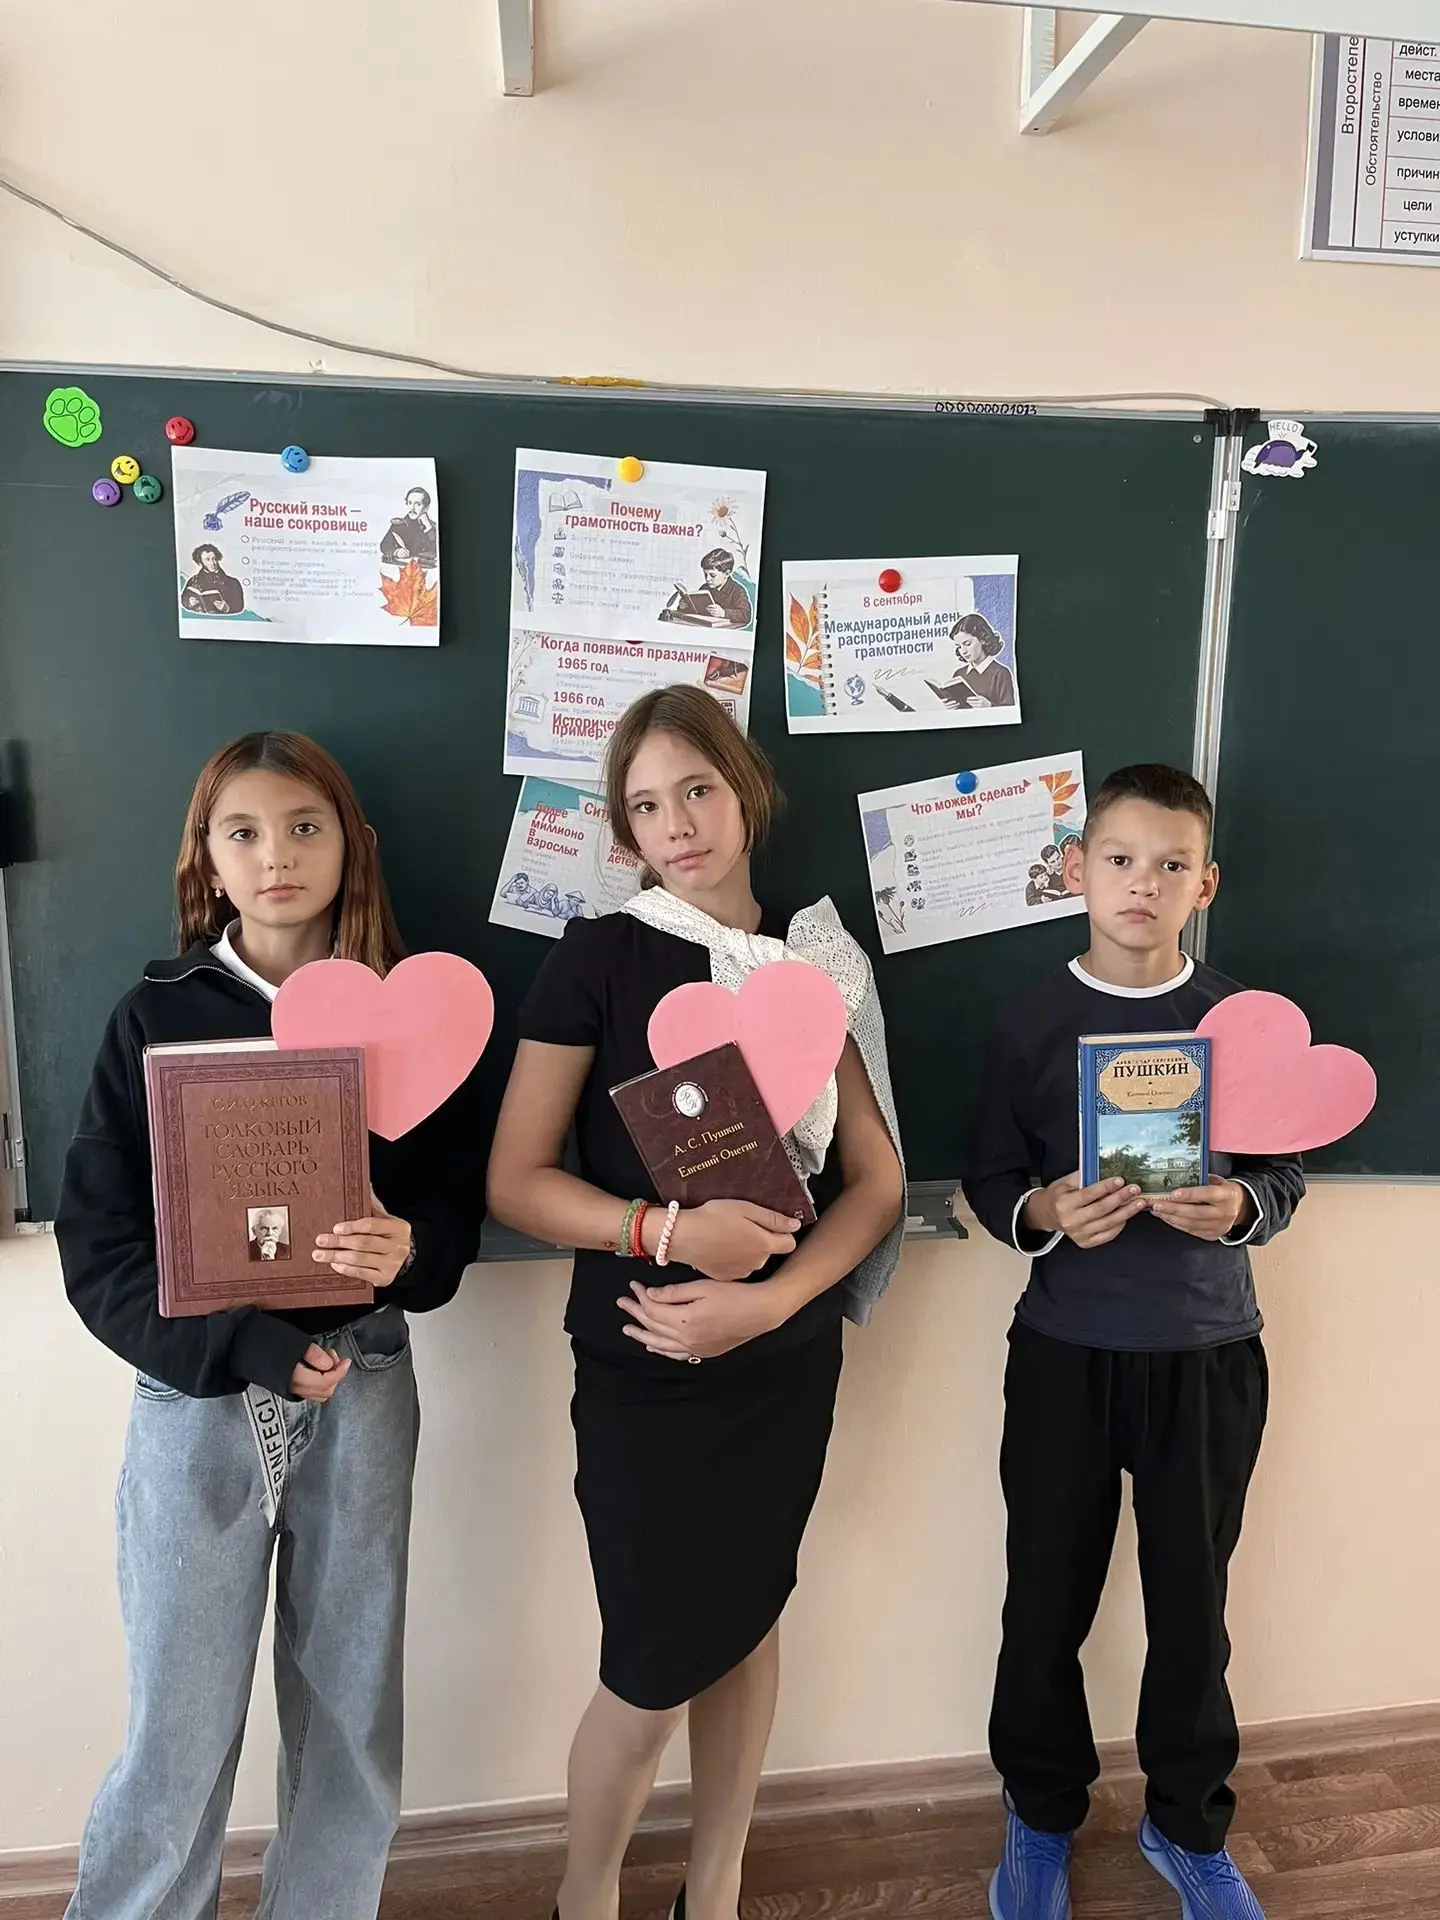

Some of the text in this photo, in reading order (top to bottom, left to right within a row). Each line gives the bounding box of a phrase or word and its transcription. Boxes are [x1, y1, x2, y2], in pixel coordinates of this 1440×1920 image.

[1399, 43, 1437, 57] дейст.
[1405, 69, 1440, 82] места
[1365, 71, 1383, 186] Обстоятельство
[1397, 129, 1440, 142] услови
[1396, 167, 1440, 181] причин
[1403, 200, 1433, 212] цели
[1394, 230, 1440, 244] уступки
[249, 498, 309, 516] Русский
[311, 504, 348, 516] язык
[610, 501, 661, 522] Почему
[244, 515, 368, 533] наше сокровище
[565, 514, 703, 538] грамотность важна?
[863, 593, 923, 608] 8 сентября
[824, 612, 931, 634] Международный
[541, 635, 580, 653] Когда
[583, 642, 644, 658] появился
[837, 626, 949, 649] распространения
[855, 642, 934, 661] грамотности
[558, 656, 588, 671] 1965
[590, 661, 610, 675] год
[553, 691, 584, 705] 1966
[586, 697, 605, 709] год
[911, 784, 1027, 816] Что можем сделать
[956, 803, 983, 820] мы?
[528, 828, 536, 837] в
[530, 819, 585, 841] миллионо
[526, 836, 580, 857] взрослых
[1112, 1062, 1190, 1078] ПУШКИН
[200, 1116, 322, 1140] ТОЛКОВЫЙ
[674, 1122, 744, 1157] А. С. Пушкин
[215, 1140, 310, 1160] СЛОВАРЬ
[677, 1140, 759, 1178] Евгений Онегин
[211, 1159, 318, 1183] РУССКОГО
[229, 1180, 301, 1200] ЯЗЫКА
